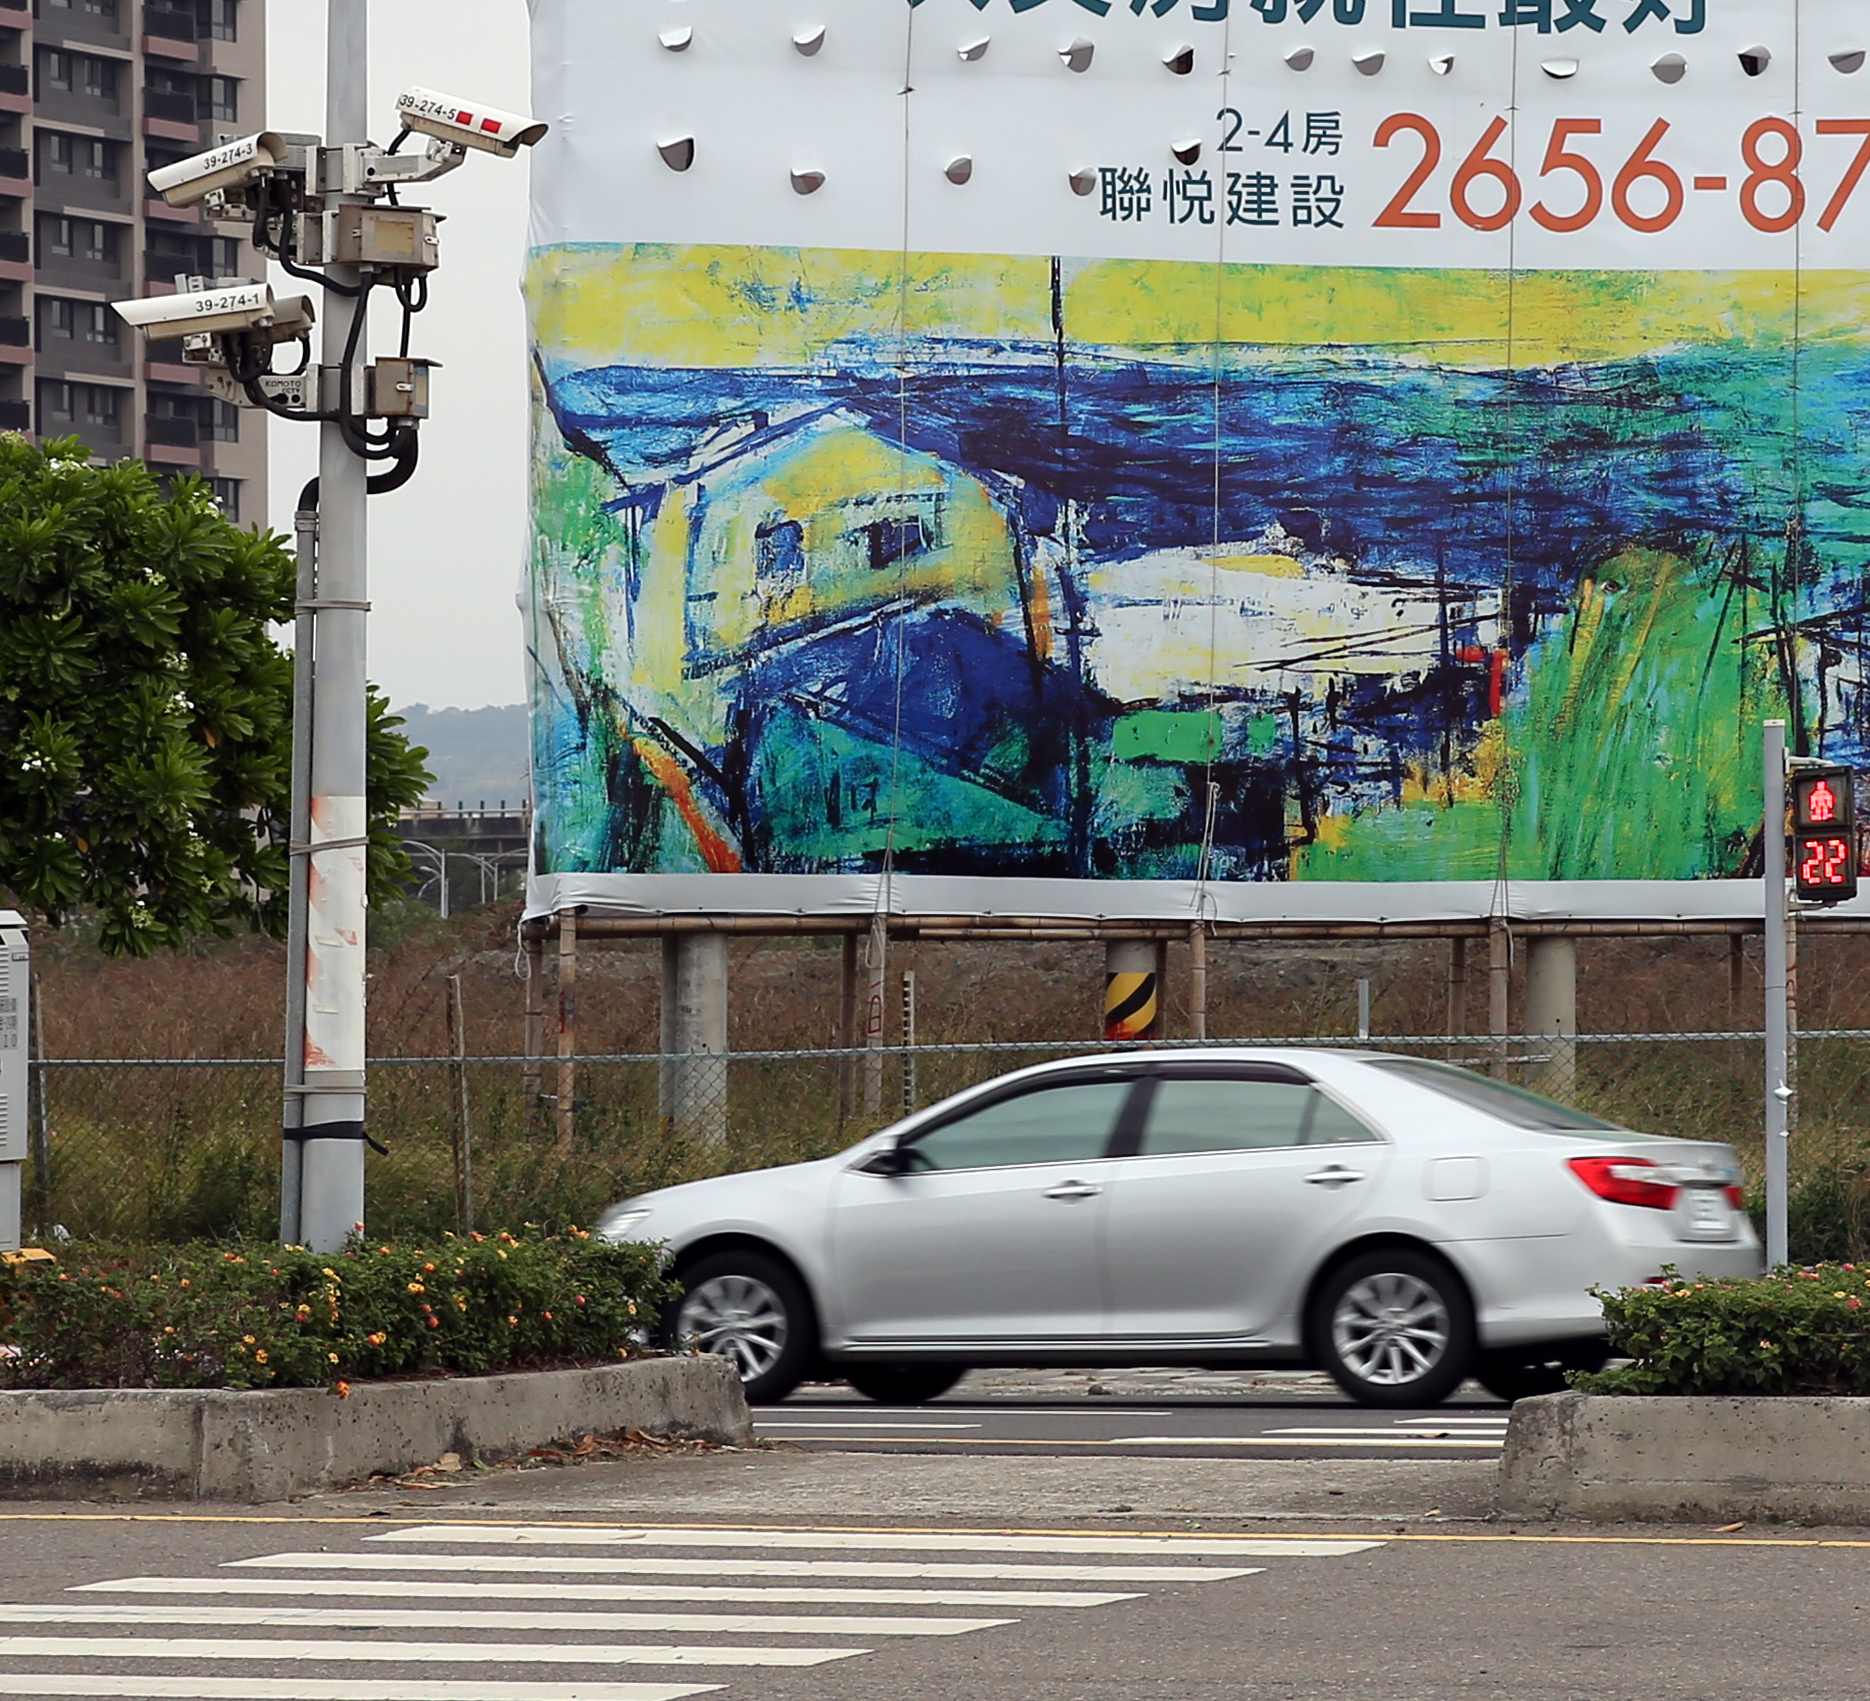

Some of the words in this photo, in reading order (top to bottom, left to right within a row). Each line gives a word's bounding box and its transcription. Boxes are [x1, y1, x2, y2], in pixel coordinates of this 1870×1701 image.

[399, 94, 456, 120] 39-274-5
[1216, 107, 1343, 156] 2-4房
[203, 142, 253, 170] 39-274-3
[196, 292, 259, 312] 39-274-1
[1801, 838, 1847, 884] 22
